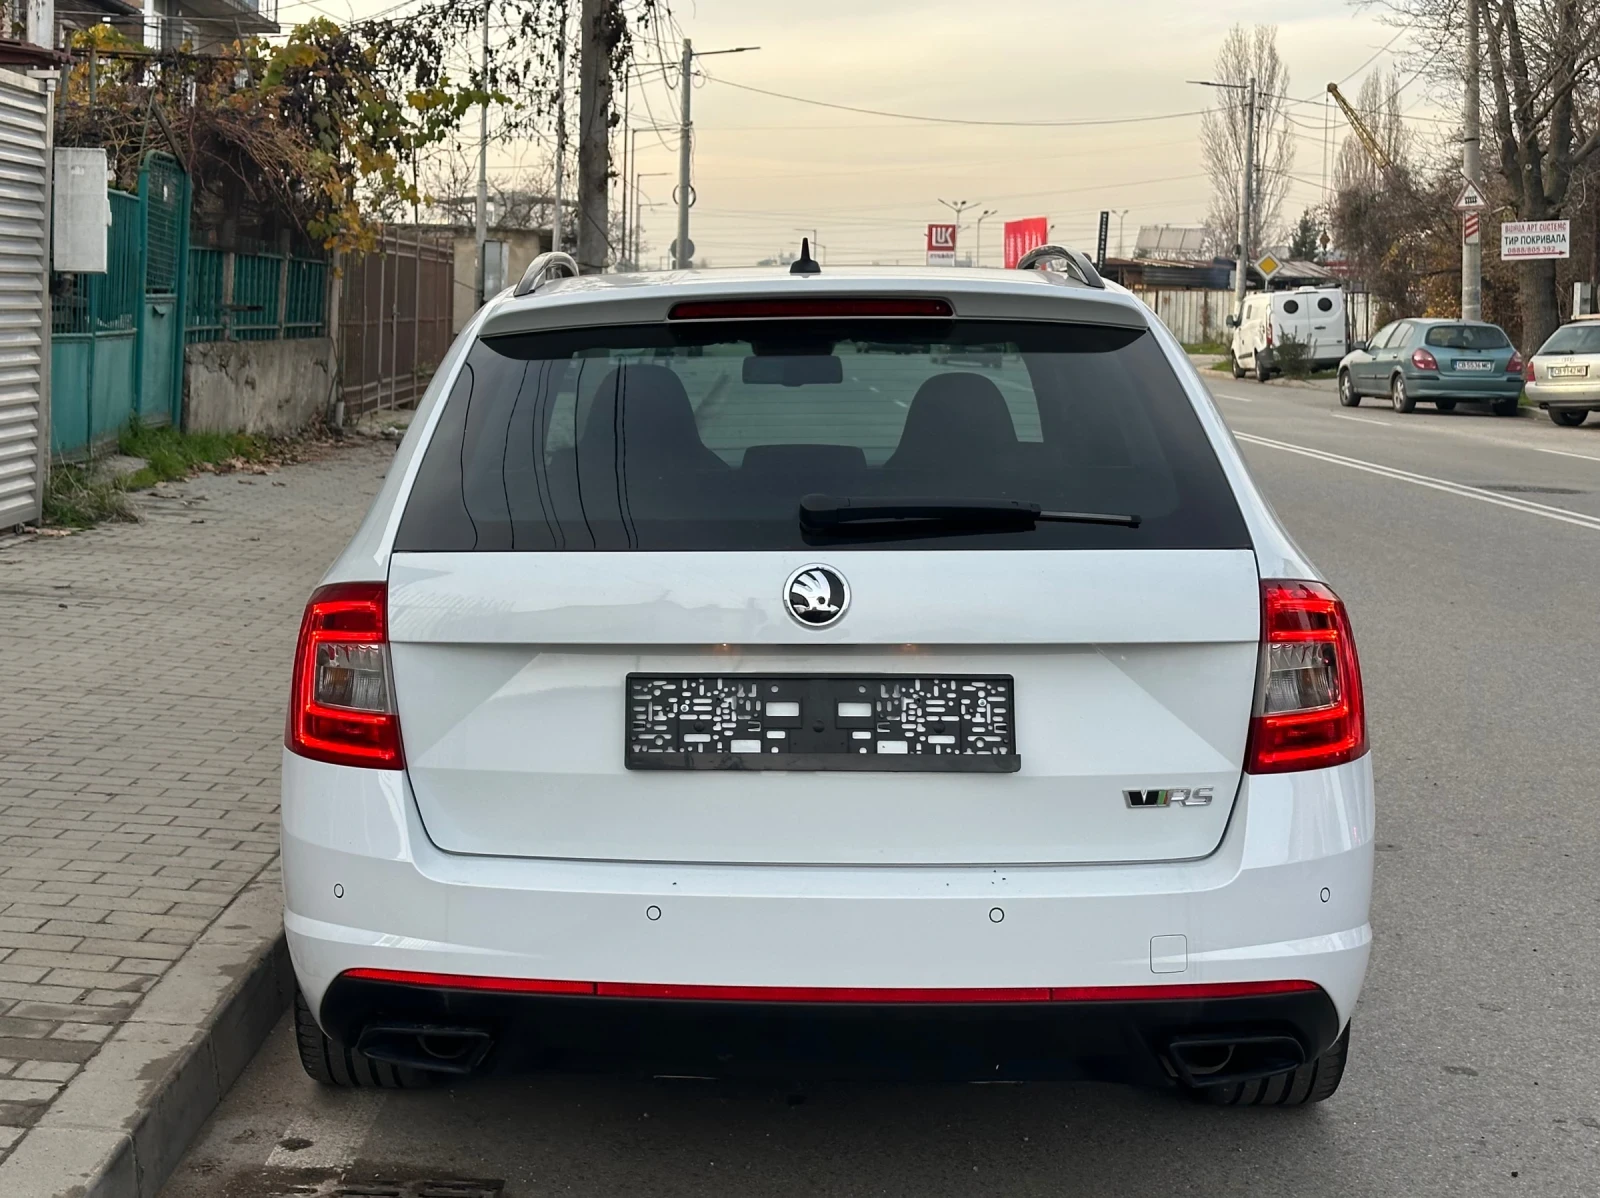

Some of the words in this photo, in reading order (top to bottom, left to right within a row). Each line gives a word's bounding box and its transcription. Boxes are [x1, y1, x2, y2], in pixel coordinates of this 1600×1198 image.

[1527, 223, 1538, 232] АРТ
[1504, 236, 1519, 245] ТИР
[1520, 234, 1567, 245] ПОКРИВАЛА
